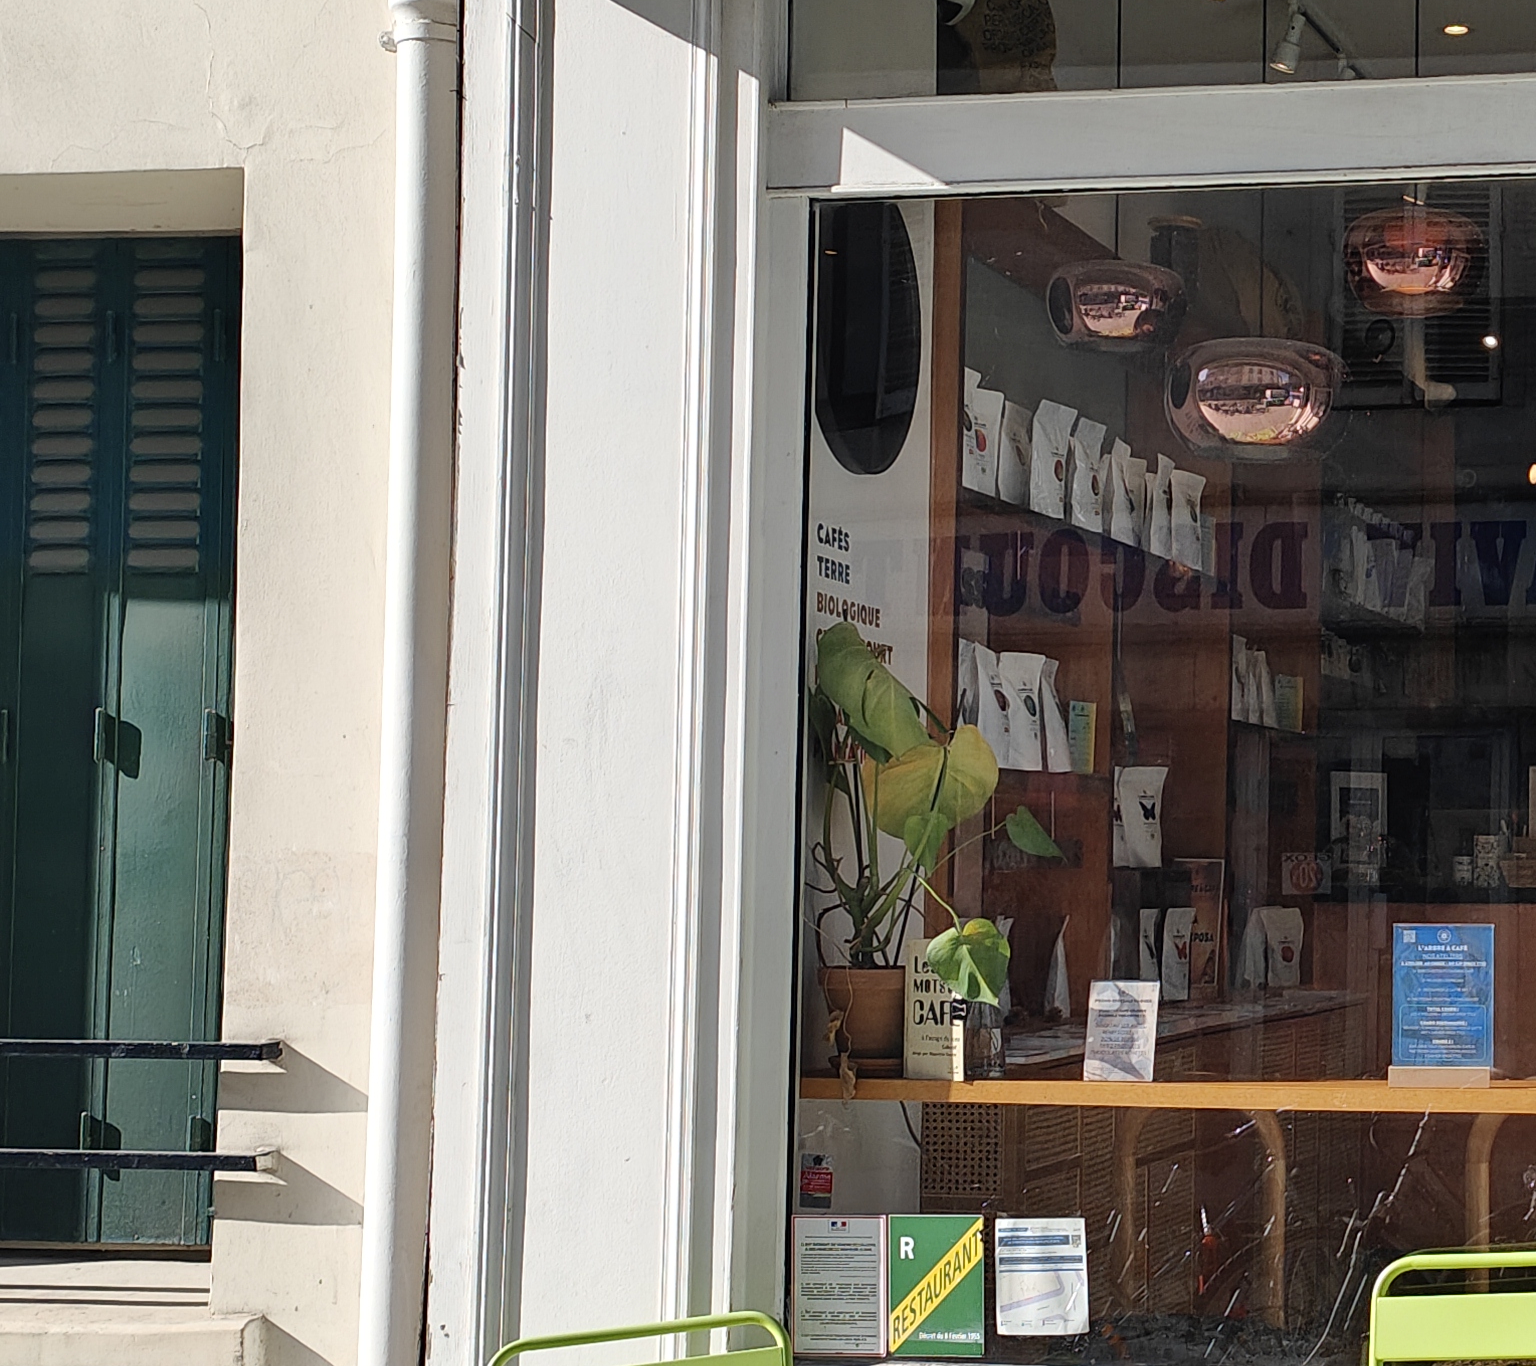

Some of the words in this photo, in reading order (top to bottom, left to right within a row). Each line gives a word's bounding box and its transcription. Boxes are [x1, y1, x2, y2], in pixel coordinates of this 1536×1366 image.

[816, 522, 850, 553] CAFÉS
[816, 554, 851, 585] TERRE
[816, 591, 881, 629] BIOLOGIQUE
[899, 1236, 915, 1260] R
[892, 1228, 983, 1345] RESTAURANT
